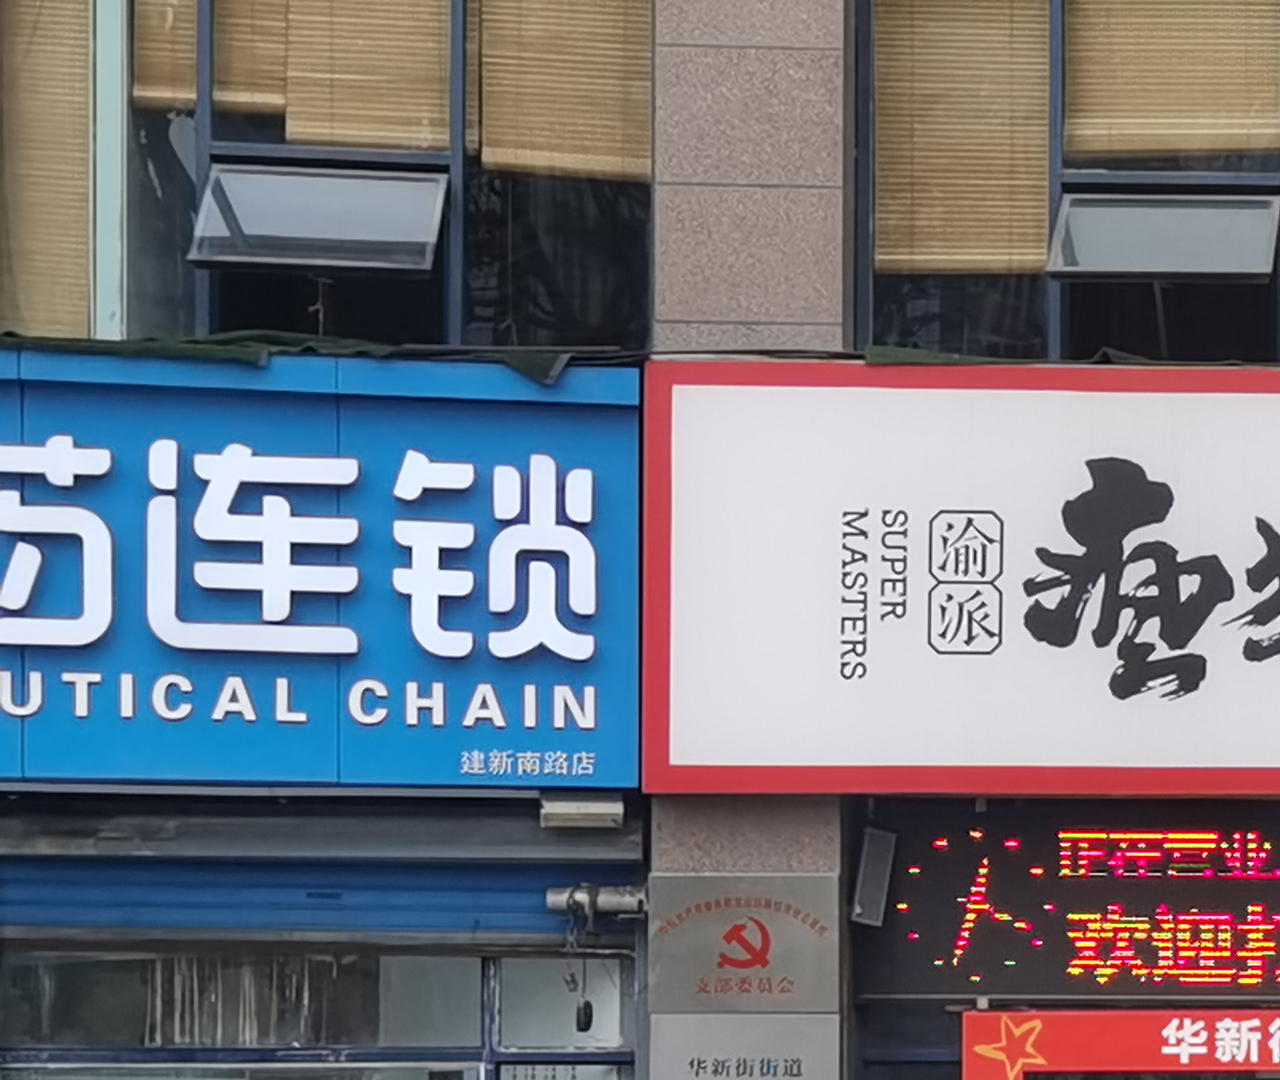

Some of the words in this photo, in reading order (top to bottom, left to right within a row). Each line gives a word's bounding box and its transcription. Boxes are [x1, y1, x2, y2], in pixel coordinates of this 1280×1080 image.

[839, 508, 869, 681] MASTERS
[880, 509, 908, 622] SUPER
[937, 516, 999, 647] 渝派
[0, 672, 308, 722] UTICAL
[348, 679, 596, 729] CHAIN
[460, 750, 595, 776] 建新南路店
[688, 1057, 803, 1079] 华新街街道
